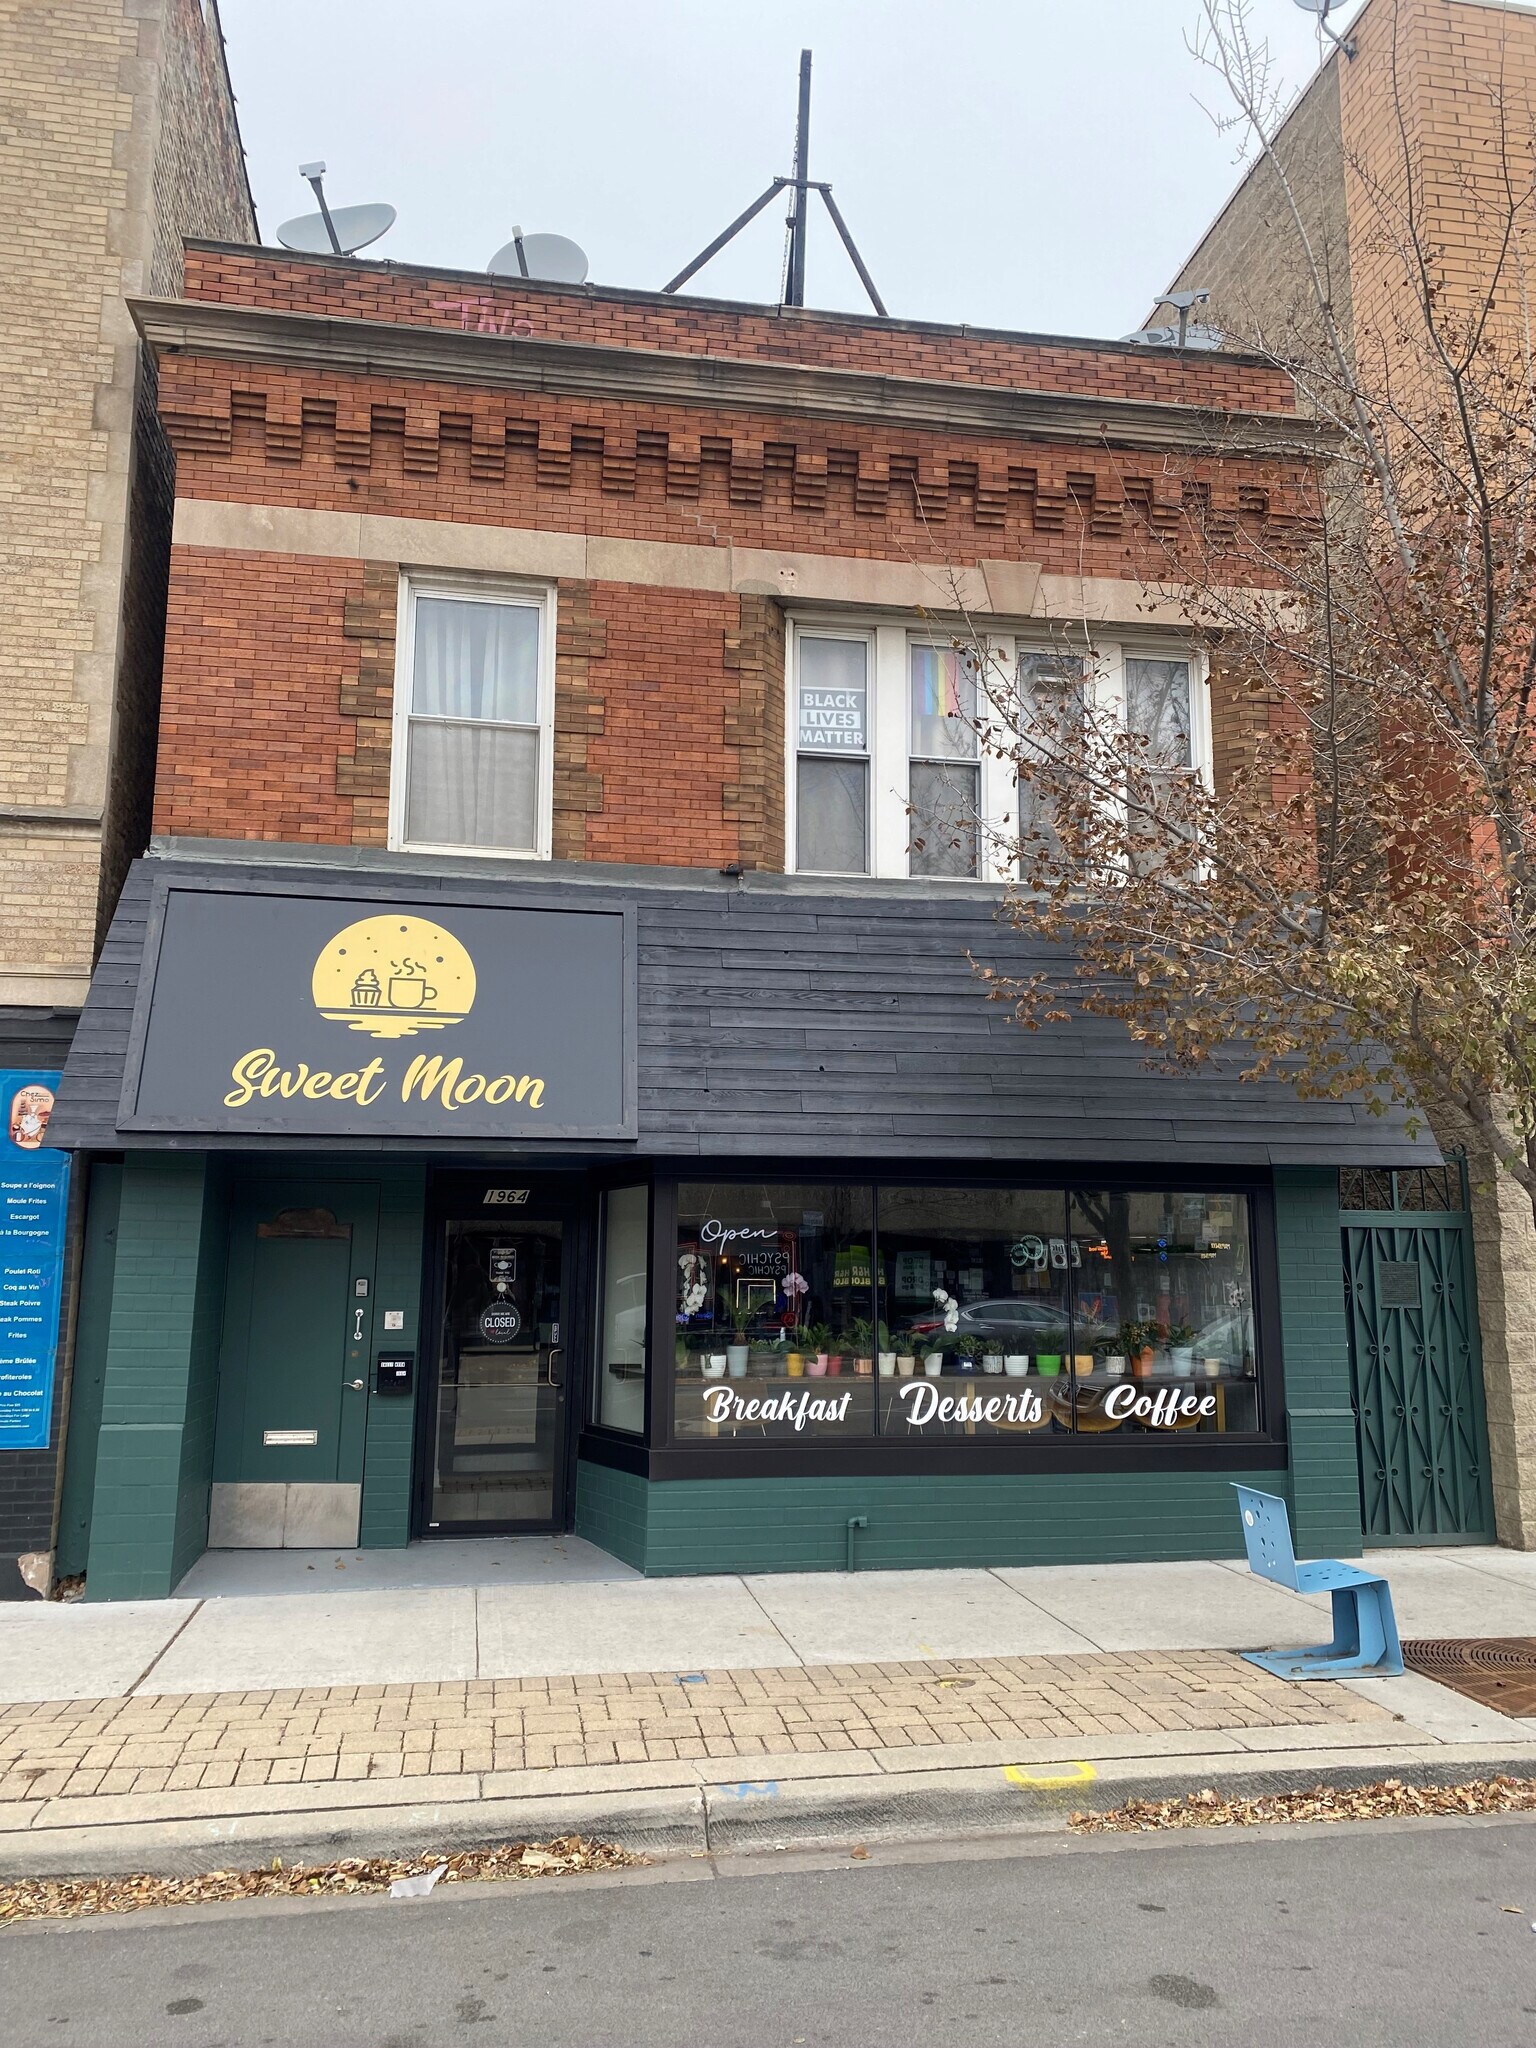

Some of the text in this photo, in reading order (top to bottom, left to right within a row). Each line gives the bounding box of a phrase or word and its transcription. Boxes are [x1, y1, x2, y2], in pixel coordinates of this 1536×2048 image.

[803, 693, 858, 709] BLACK
[806, 711, 855, 727] LIVES
[799, 729, 864, 745] MATTER
[223, 1048, 546, 1111] Sweet Moon
[29, 1182, 56, 1190] l'oignon
[487, 1190, 528, 1203] 1964
[10, 1213, 40, 1221] Escargot
[13, 1229, 50, 1237] Bourgogne
[701, 1219, 778, 1255] Open
[3, 1284, 17, 1292] Coq
[484, 1316, 516, 1328] CLOSED
[702, 1386, 853, 1431] Breakfast
[899, 1382, 1043, 1426] Desserts
[1104, 1384, 1217, 1427] Coffee
